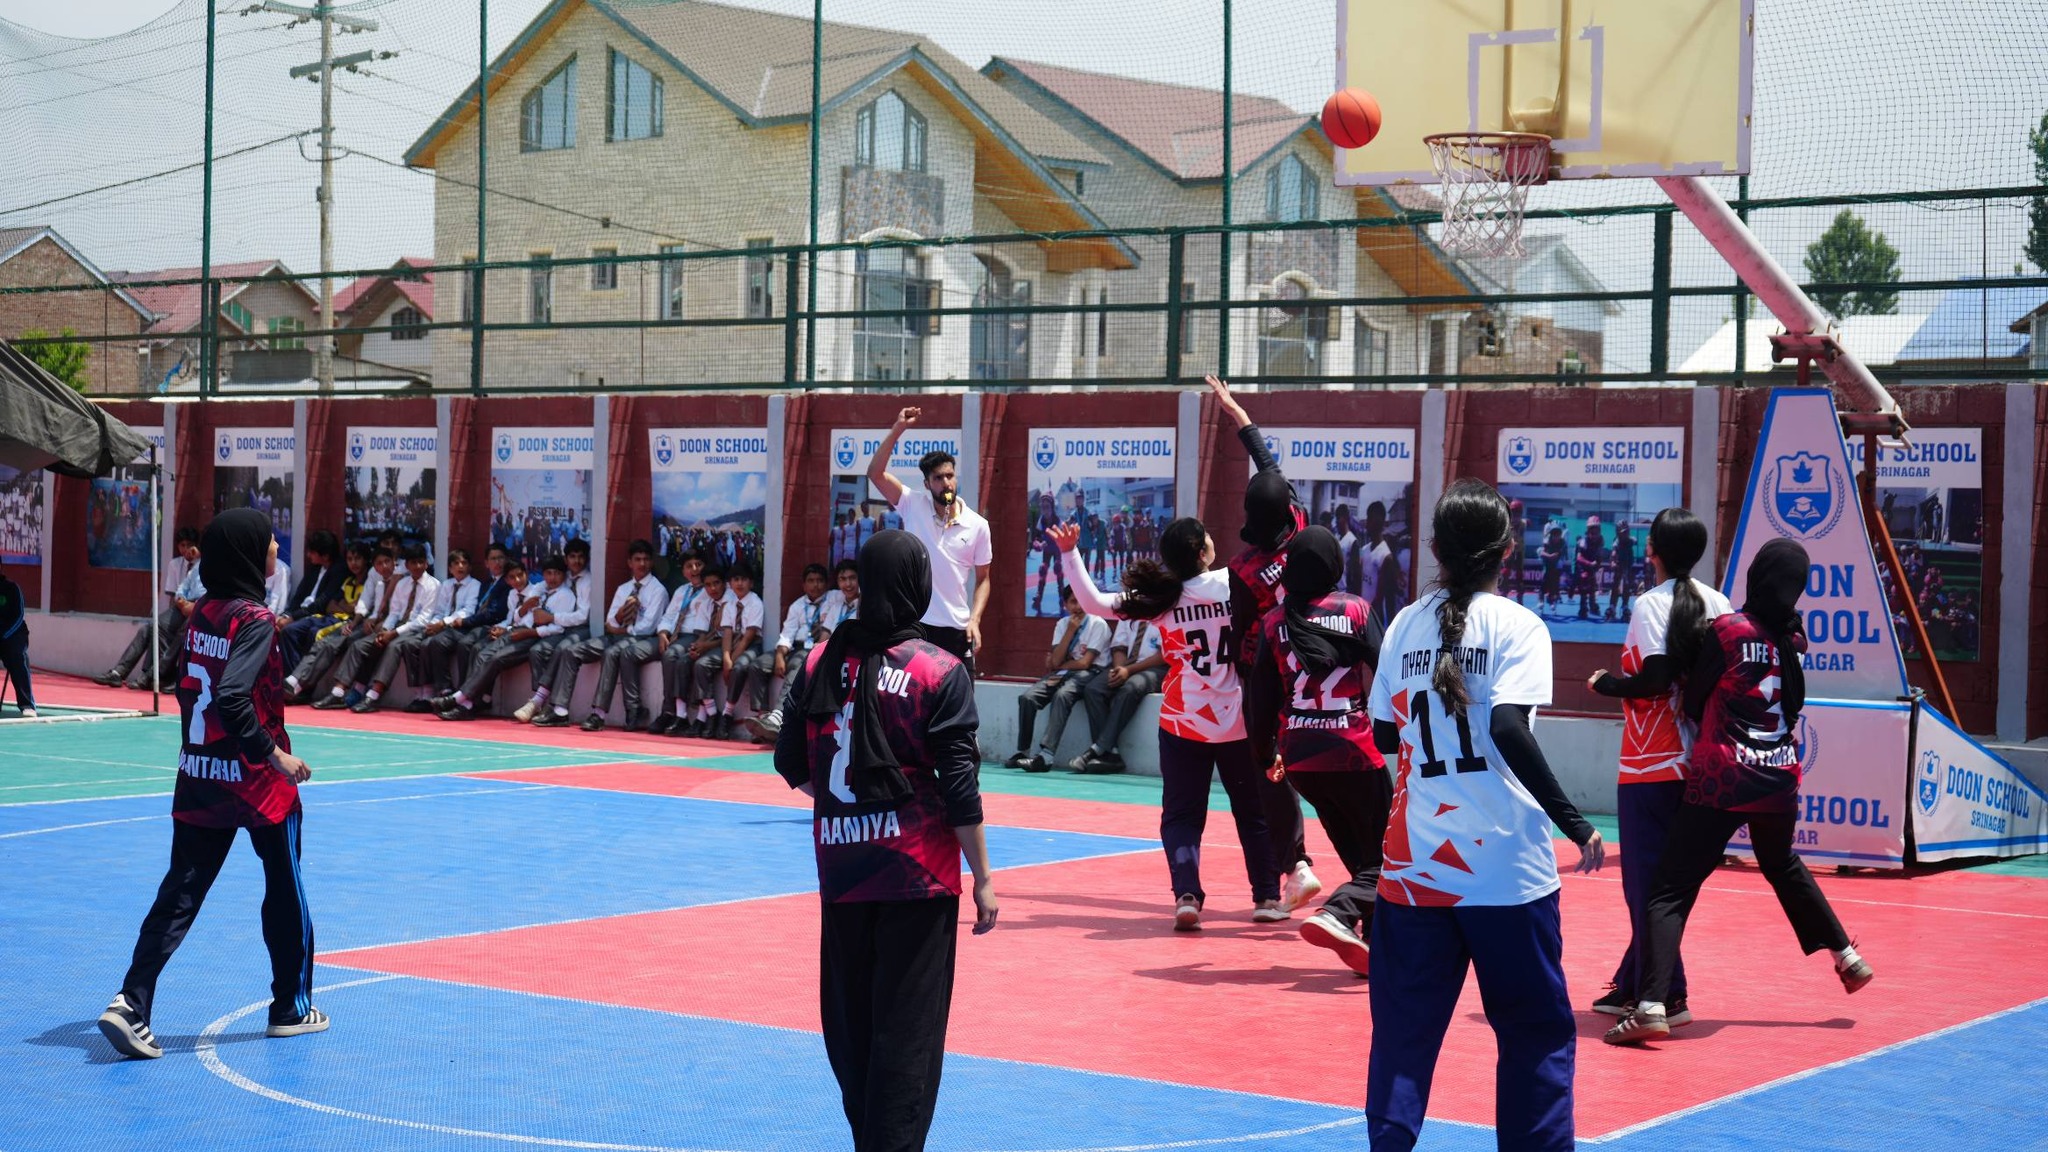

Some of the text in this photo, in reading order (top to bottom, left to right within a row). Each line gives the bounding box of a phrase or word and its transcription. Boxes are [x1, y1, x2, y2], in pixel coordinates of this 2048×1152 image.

[236, 437, 295, 450] DOON SCHOO
[369, 437, 396, 451] DOON
[518, 438, 549, 451] DOON
[680, 438, 768, 453] DOON SCHOOL
[904, 441, 958, 456] SCHOOL
[1065, 440, 1171, 456] DOON SCHOOL
[1291, 441, 1410, 459] DOON SCHOOL
[1544, 441, 1678, 460] DOON SCHOOL
[704, 456, 738, 465] SRINAGAR
[1893, 443, 1976, 463] SCHOOL
[891, 459, 919, 467] SRINAG
[1097, 459, 1137, 469] SRINAGAR
[1326, 461, 1371, 472] SRINAGAR
[1585, 463, 1636, 474] SRINAGAR
[1875, 466, 1930, 477] SRINAGAR
[1185, 625, 1233, 677] 24
[1742, 642, 1768, 664] LIFE
[1402, 649, 1431, 680] MYRA
[1410, 690, 1488, 779] 11
[1946, 764, 2030, 820] DOON SCHOOL
[820, 810, 901, 845] AANIYA
[1970, 810, 2006, 834] SRINAGAR
